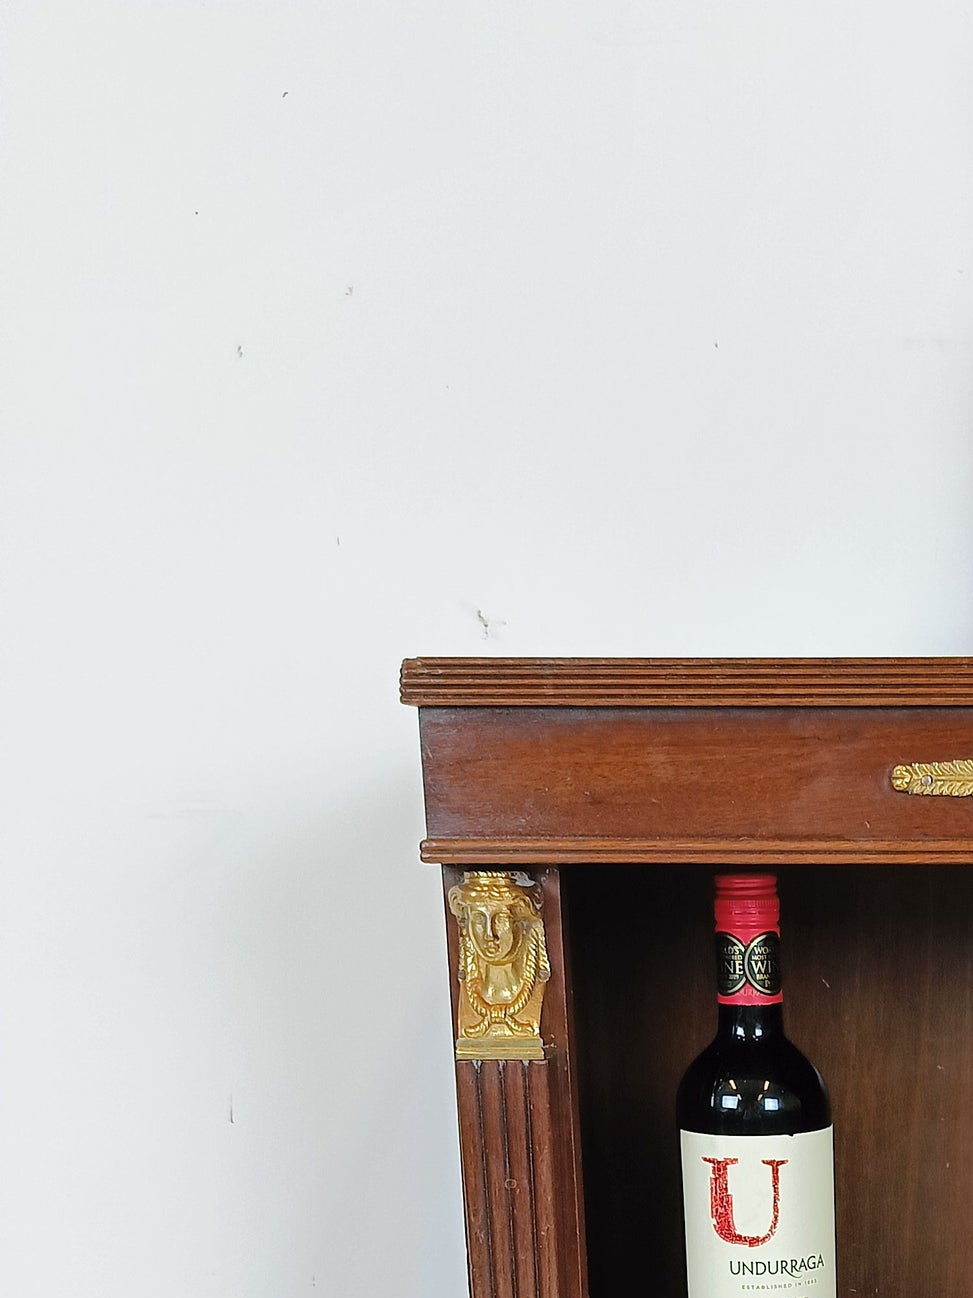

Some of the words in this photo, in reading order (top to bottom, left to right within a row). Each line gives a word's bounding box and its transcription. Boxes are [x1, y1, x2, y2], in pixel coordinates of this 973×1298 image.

[701, 1156, 789, 1248] U
[729, 1253, 825, 1279] UNDURRAGA
[741, 1282, 793, 1290] ESTABLISHED
